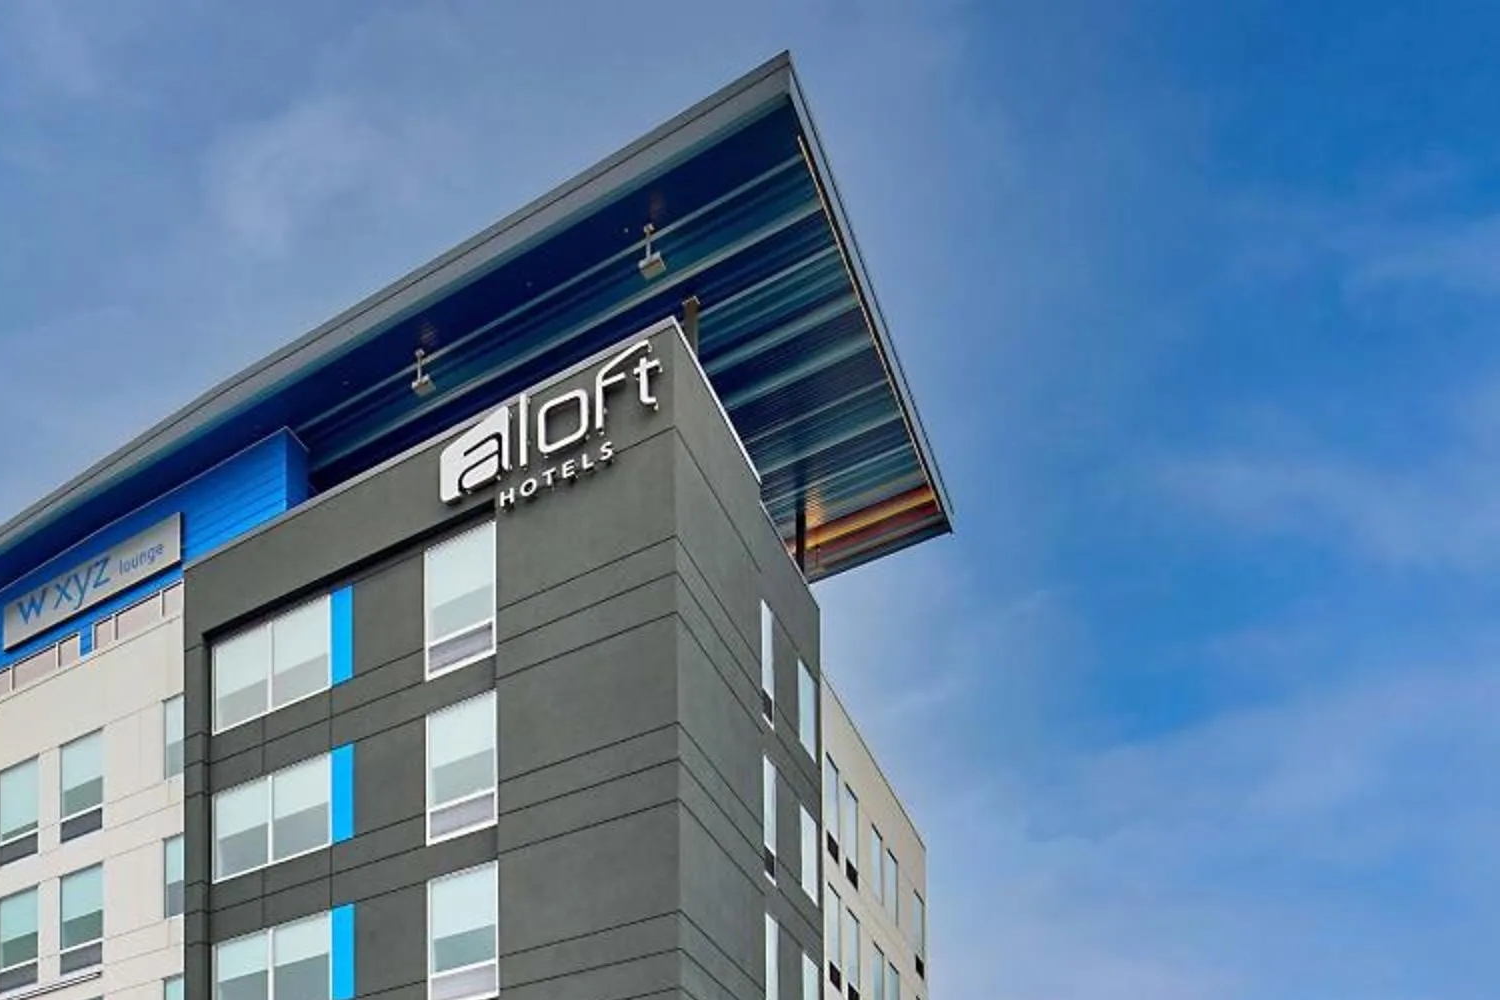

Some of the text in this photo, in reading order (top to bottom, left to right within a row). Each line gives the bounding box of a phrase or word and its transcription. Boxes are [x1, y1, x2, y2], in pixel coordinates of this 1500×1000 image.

[440, 340, 661, 502] aloft
[500, 441, 614, 507] HOTELS
[118, 543, 165, 574] lounge
